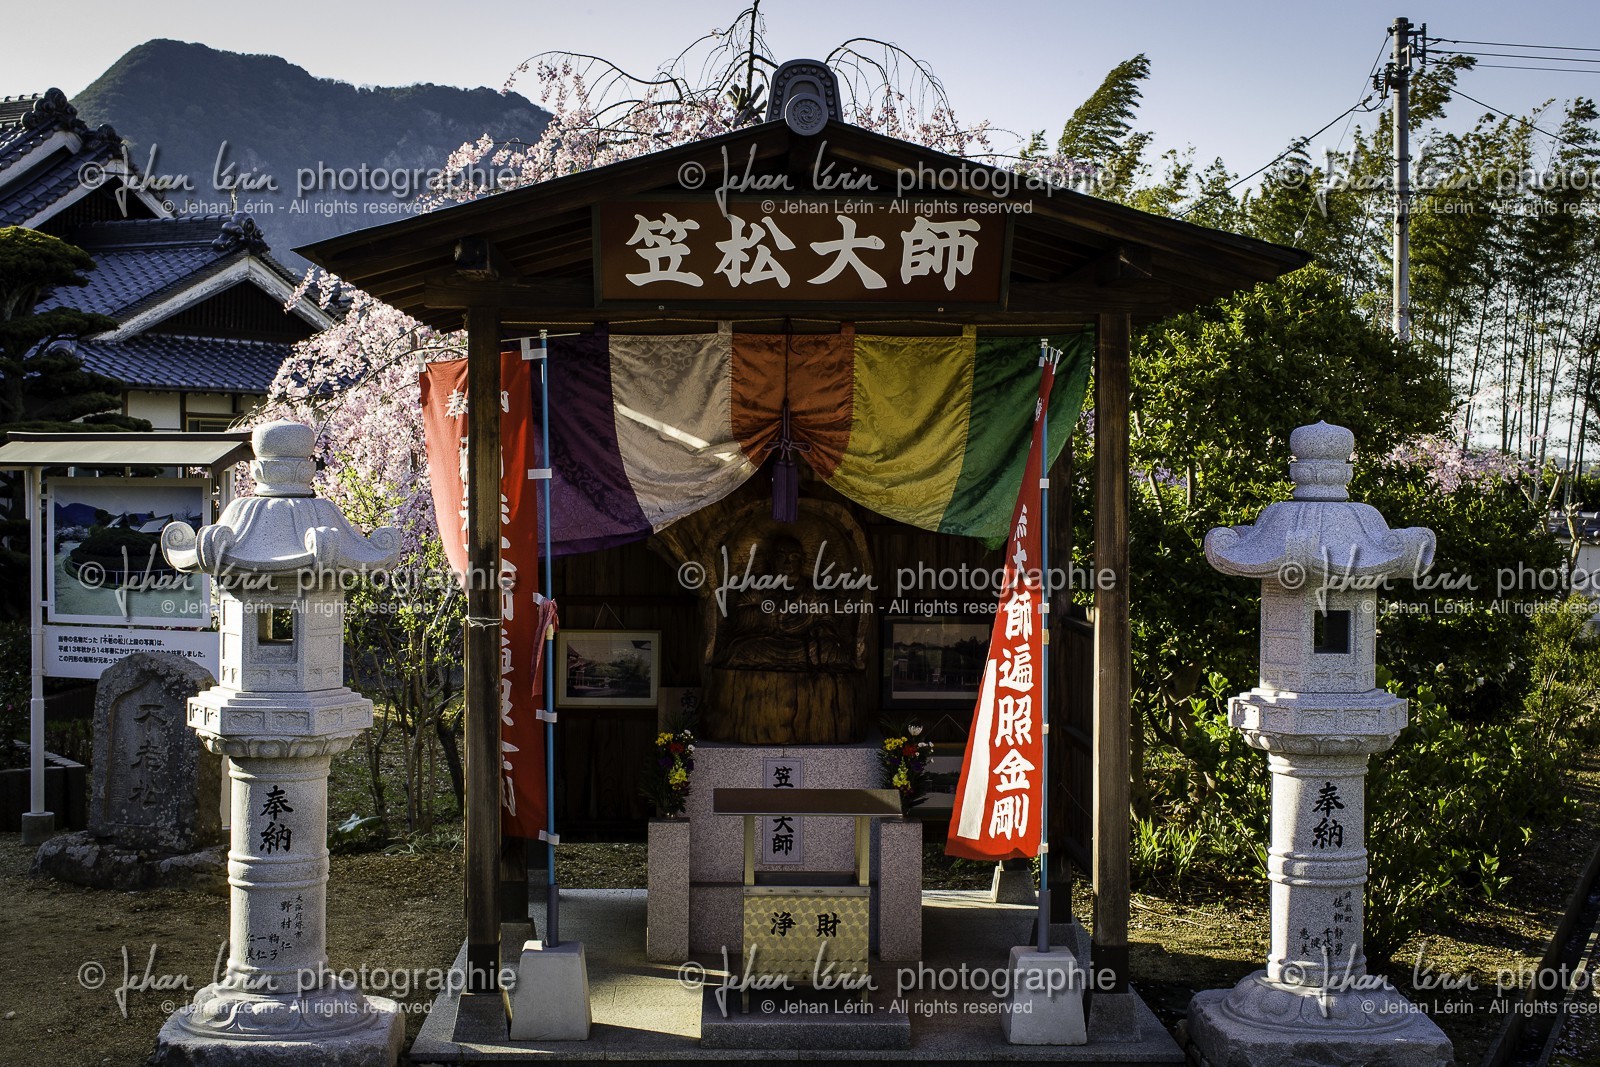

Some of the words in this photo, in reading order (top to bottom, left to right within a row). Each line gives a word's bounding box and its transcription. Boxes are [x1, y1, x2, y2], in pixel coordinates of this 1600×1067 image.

[625, 213, 981, 291] 笠松大師
[260, 785, 294, 855] 奉納
[772, 766, 794, 856] 笠大師
[1312, 782, 1345, 849] 奉納
[770, 911, 841, 938] 浄財
